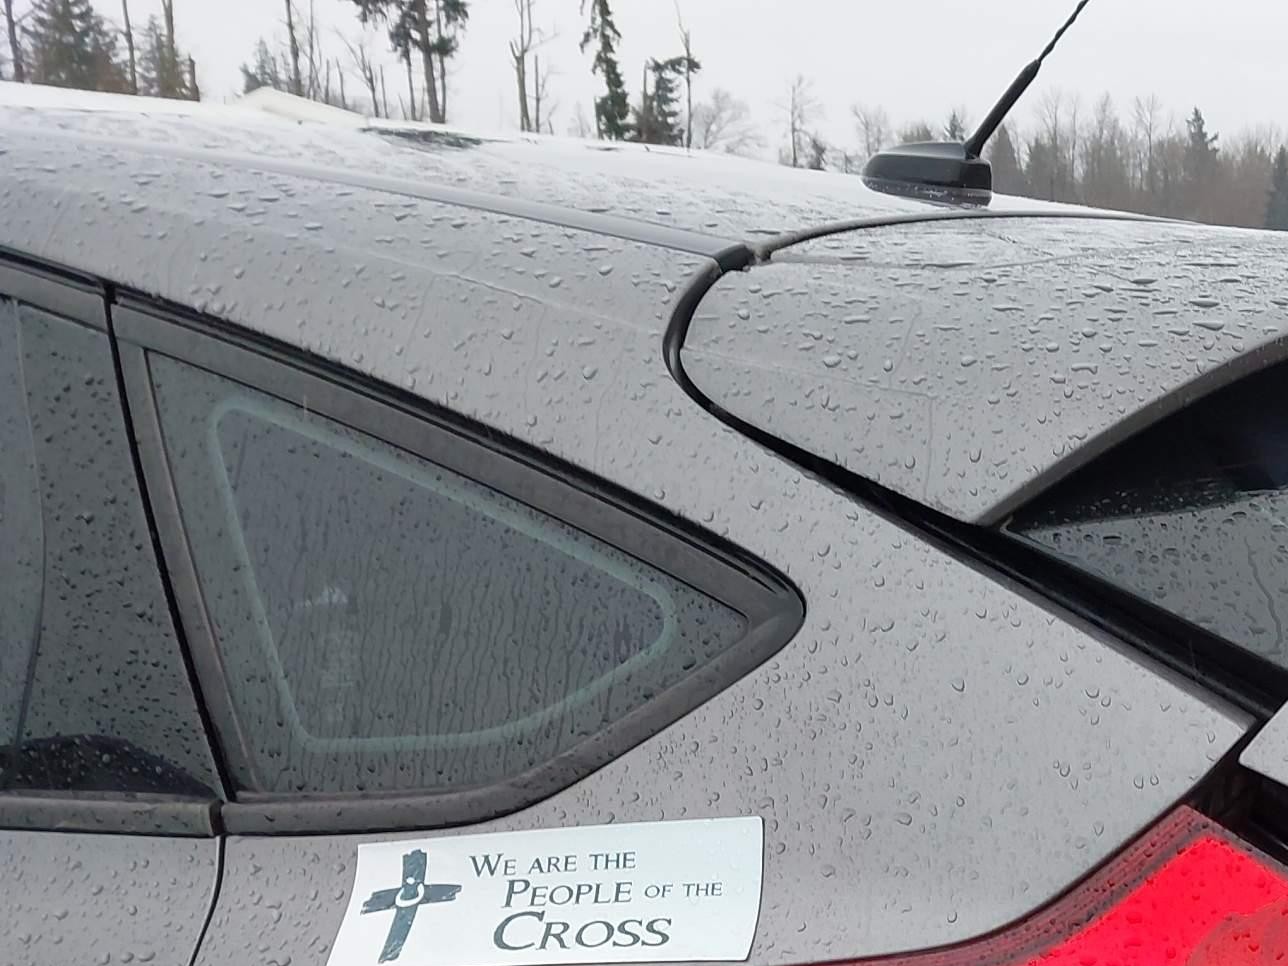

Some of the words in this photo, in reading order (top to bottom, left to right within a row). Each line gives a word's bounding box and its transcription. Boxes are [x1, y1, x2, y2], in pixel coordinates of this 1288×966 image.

[469, 852, 517, 877] WE
[527, 854, 578, 875] ARE
[589, 850, 637, 871] THE
[502, 880, 633, 909] PEOPLE
[643, 884, 673, 899] OF
[685, 881, 723, 898] THE
[493, 910, 673, 951] CROSS
